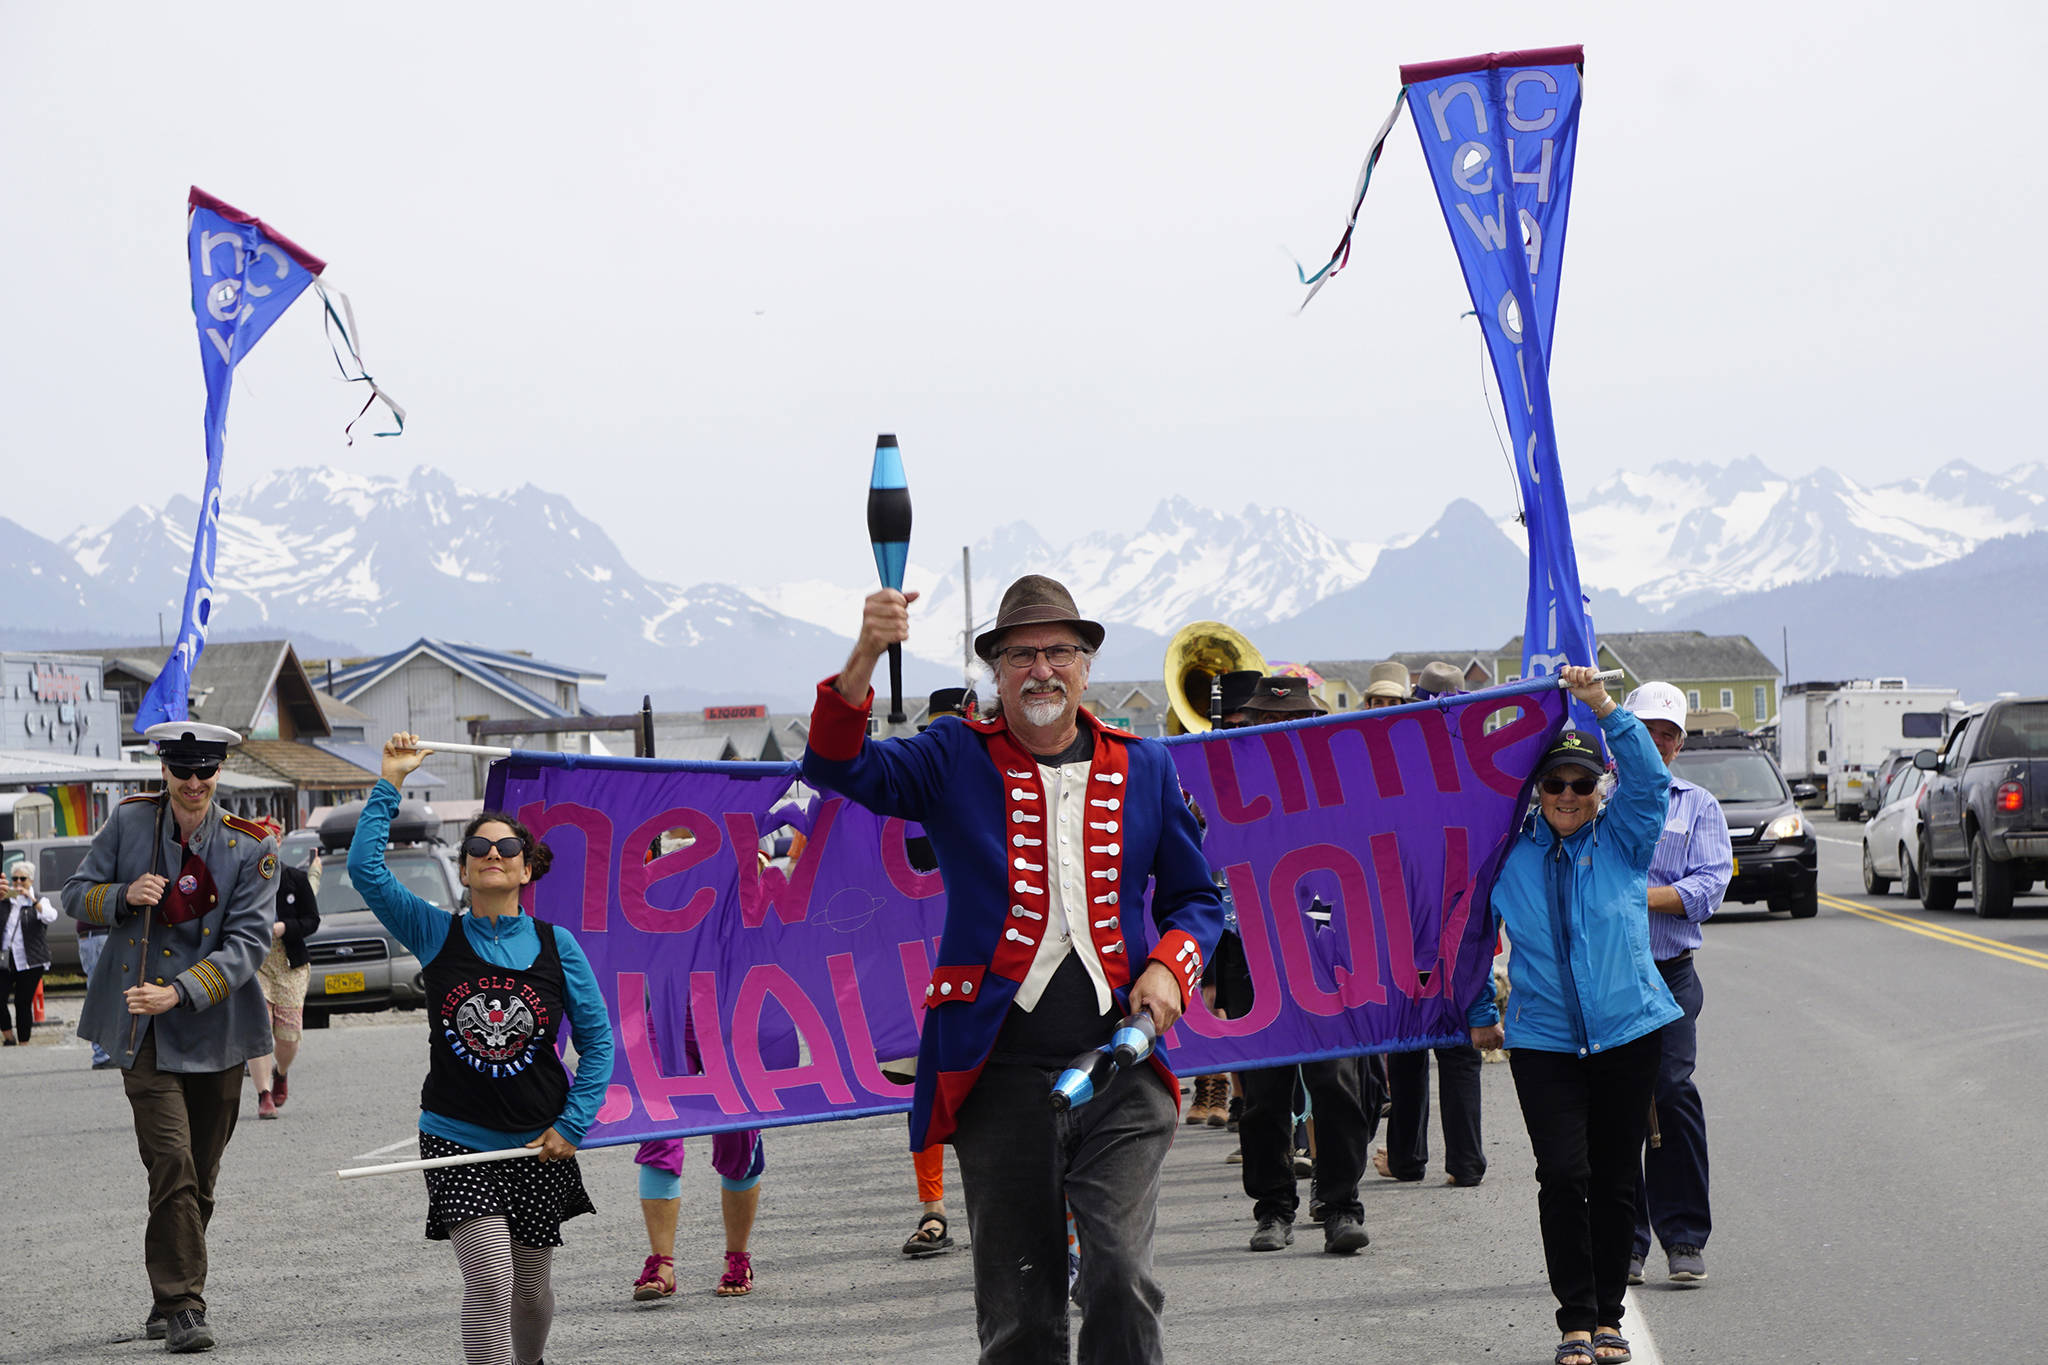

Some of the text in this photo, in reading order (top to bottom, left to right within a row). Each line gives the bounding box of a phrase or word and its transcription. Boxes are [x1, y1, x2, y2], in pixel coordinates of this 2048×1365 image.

[1427, 80, 1508, 252] new
[1504, 69, 1557, 300] CHA
[709, 707, 756, 719] LIQUOR
[517, 797, 843, 934] new
[1205, 691, 1548, 824] time
[440, 976, 549, 1025] NEW OLD TIME
